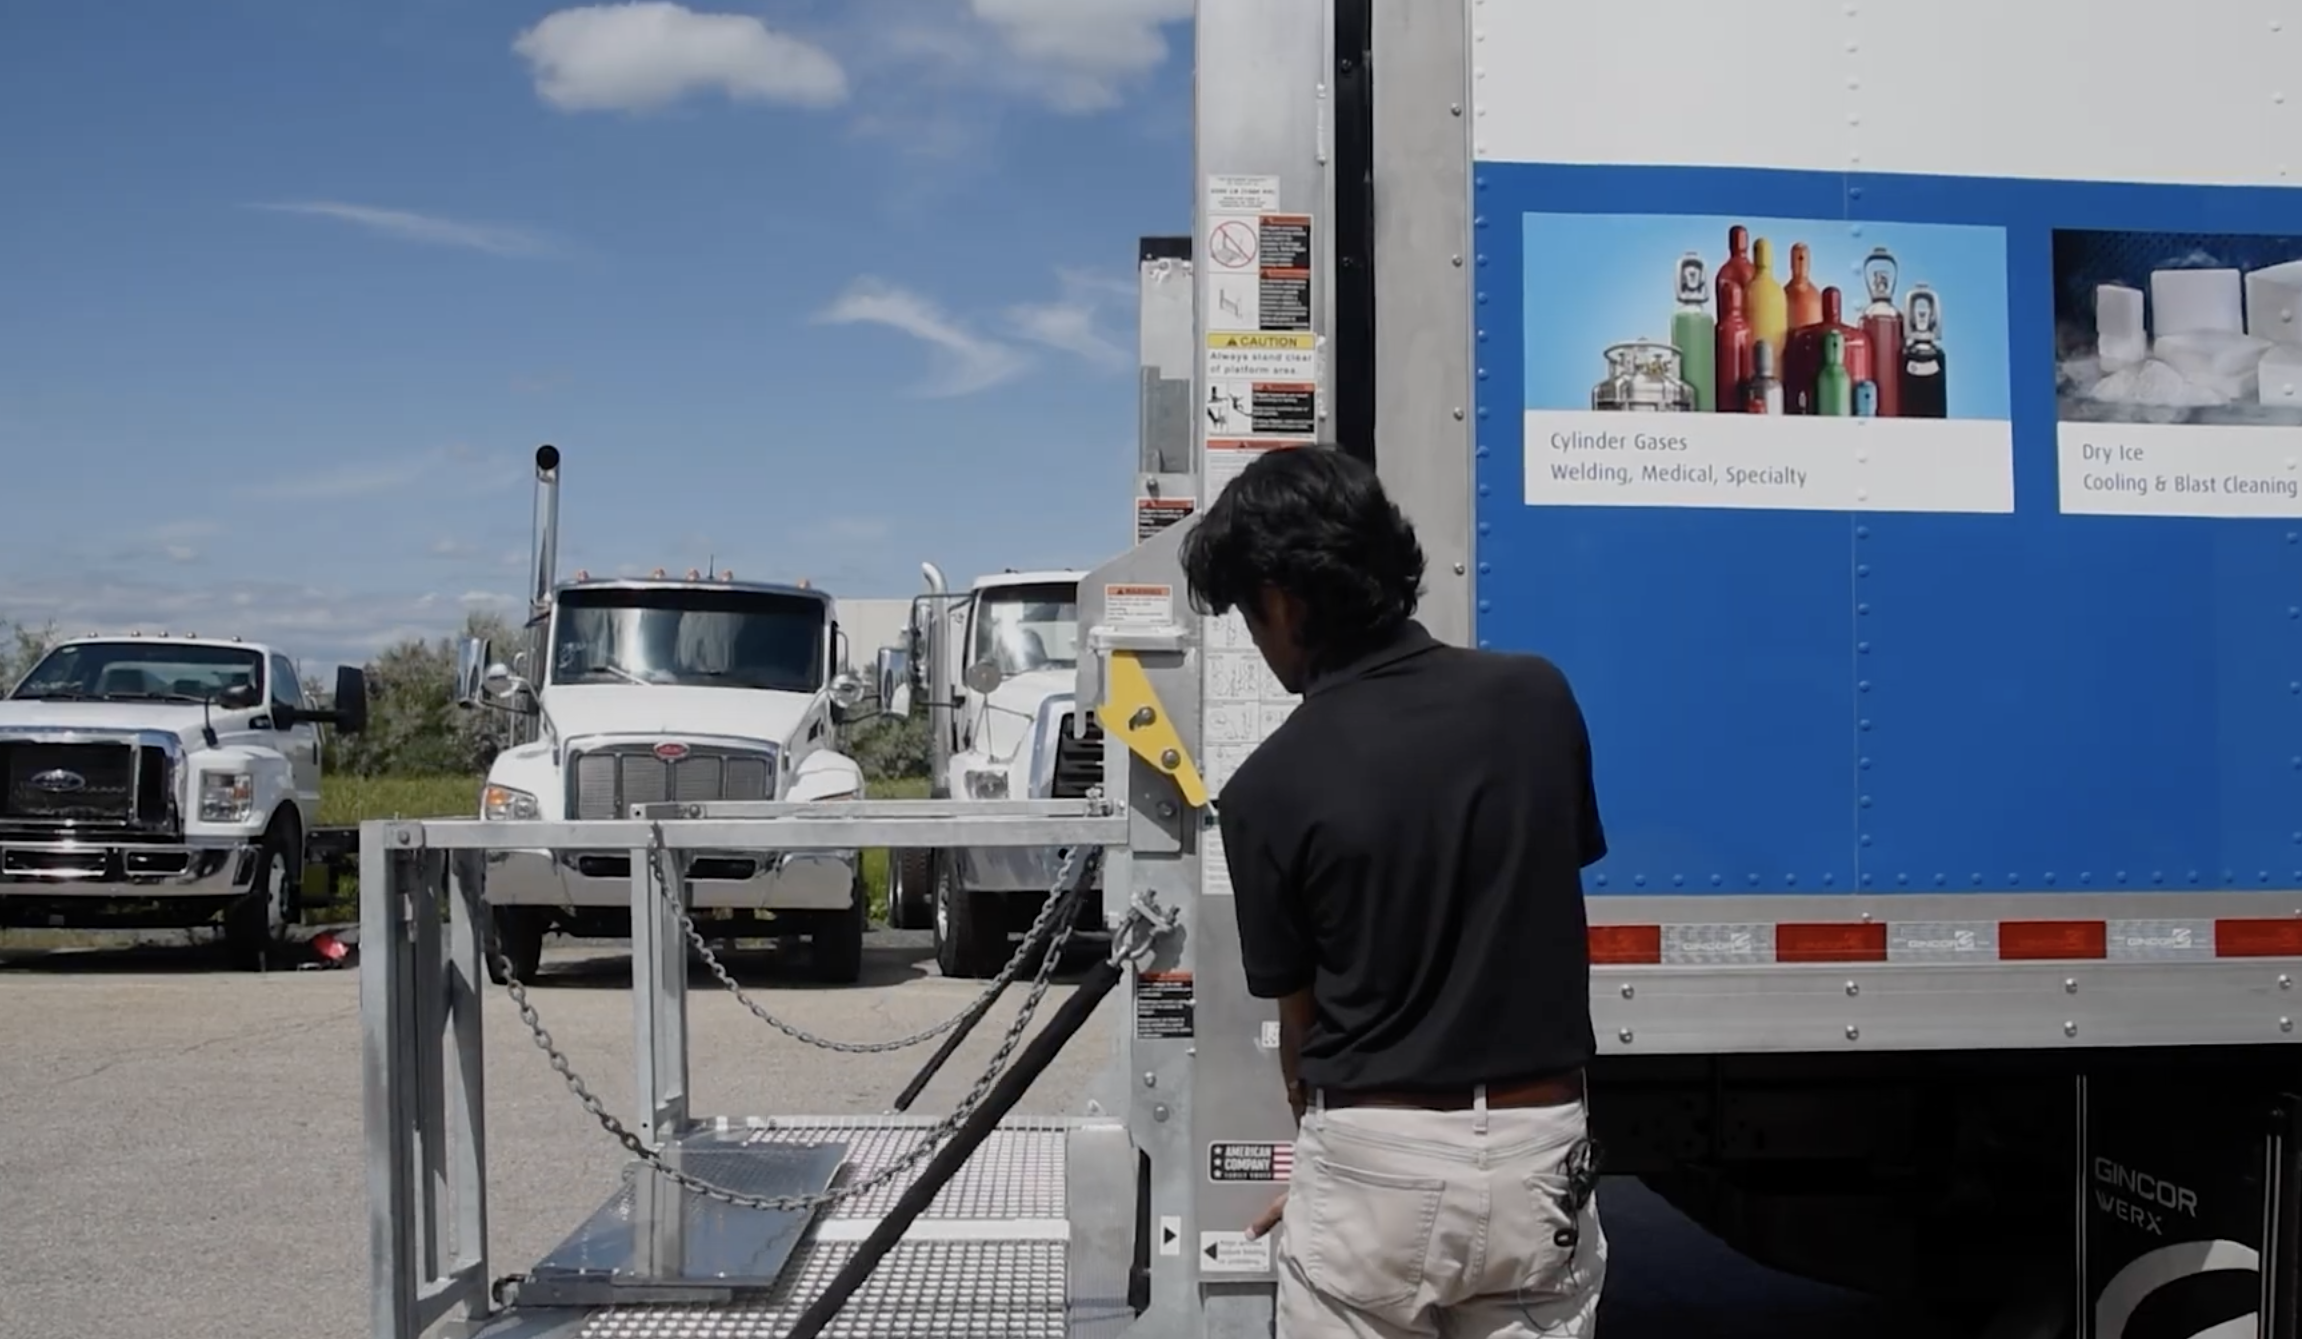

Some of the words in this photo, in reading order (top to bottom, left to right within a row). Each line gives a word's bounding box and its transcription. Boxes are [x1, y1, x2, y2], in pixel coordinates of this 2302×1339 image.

[1240, 337, 1297, 347] CAUTION
[1210, 352, 1248, 362] Always
[1252, 352, 1282, 361] stand
[1285, 352, 1311, 361] clear
[1210, 365, 1221, 373] of
[1224, 365, 1269, 374] platform
[1550, 432, 1626, 453] Cylinder
[1634, 433, 1687, 451] Gases
[2082, 443, 2112, 465] Dry
[2119, 445, 2144, 461] Ice
[1550, 463, 1634, 486] Welding,
[1641, 464, 1719, 485] Medical,
[1725, 466, 1807, 488] Specialty
[2083, 472, 2148, 496] Cooling
[2154, 475, 2167, 492] &
[2174, 474, 2216, 493] Blast
[2223, 475, 2298, 498] Cleaning
[1225, 1145, 1271, 1157] AMERICAN
[1224, 1158, 1271, 1170] COMPANY
[2095, 1156, 2198, 1218] GINCOR
[2095, 1189, 2163, 1235] WERX
